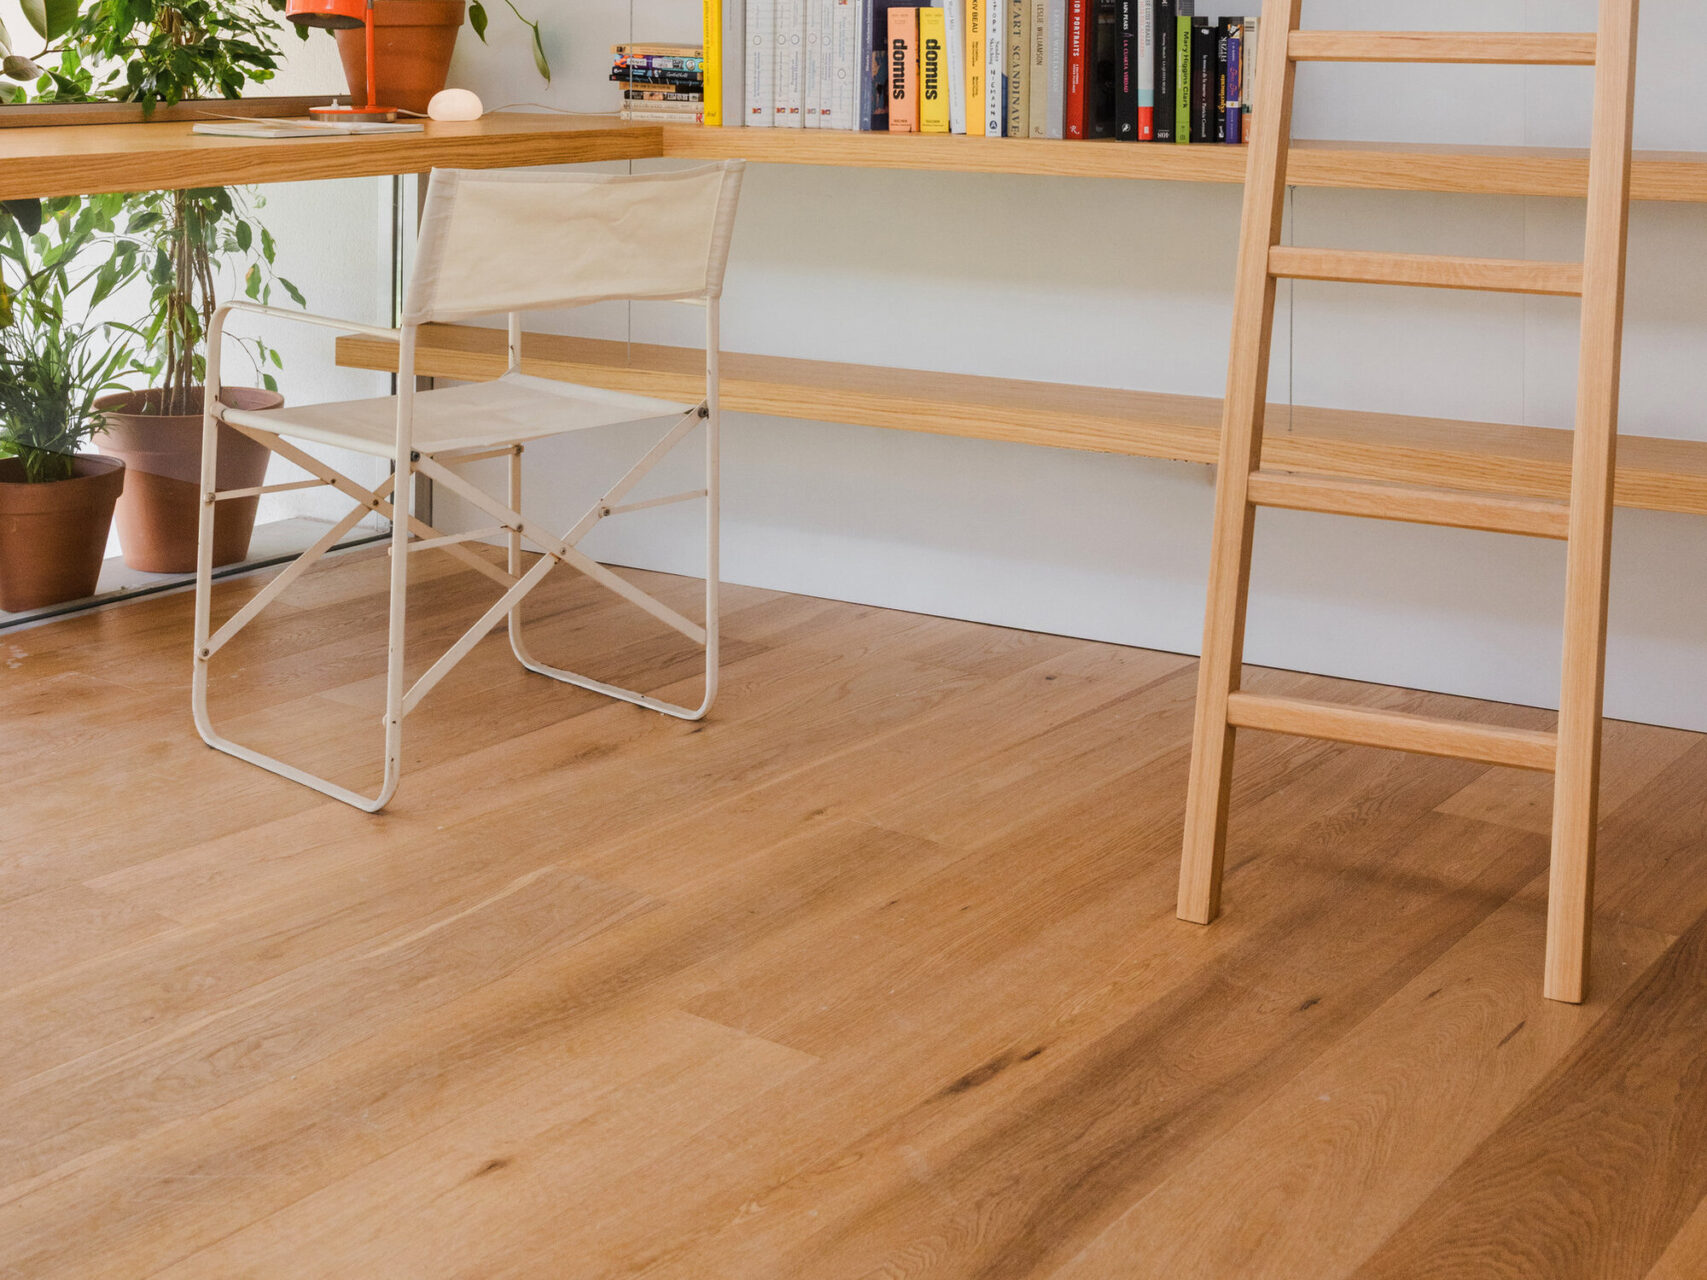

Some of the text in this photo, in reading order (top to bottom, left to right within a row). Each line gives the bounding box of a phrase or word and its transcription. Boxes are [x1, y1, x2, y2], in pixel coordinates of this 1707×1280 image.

[971, 12, 980, 34] BEAU
[1035, 3, 1045, 66] LESLIE WILLIAMSON
[1072, 15, 1081, 56] PORTRAITS
[1181, 31, 1190, 53] Mary
[1219, 35, 1228, 63] FITZEK
[892, 38, 908, 101] domus
[925, 38, 941, 101] domus
[1010, 0, 1022, 132] L'ART SCANDINAVE
[1052, 39, 1060, 92] WILLIAMSON
[1122, 47, 1130, 70] CUARTA
[1181, 54, 1190, 85] Higgins
[1122, 70, 1130, 93] VERDAD
[1182, 86, 1190, 109] Clark
